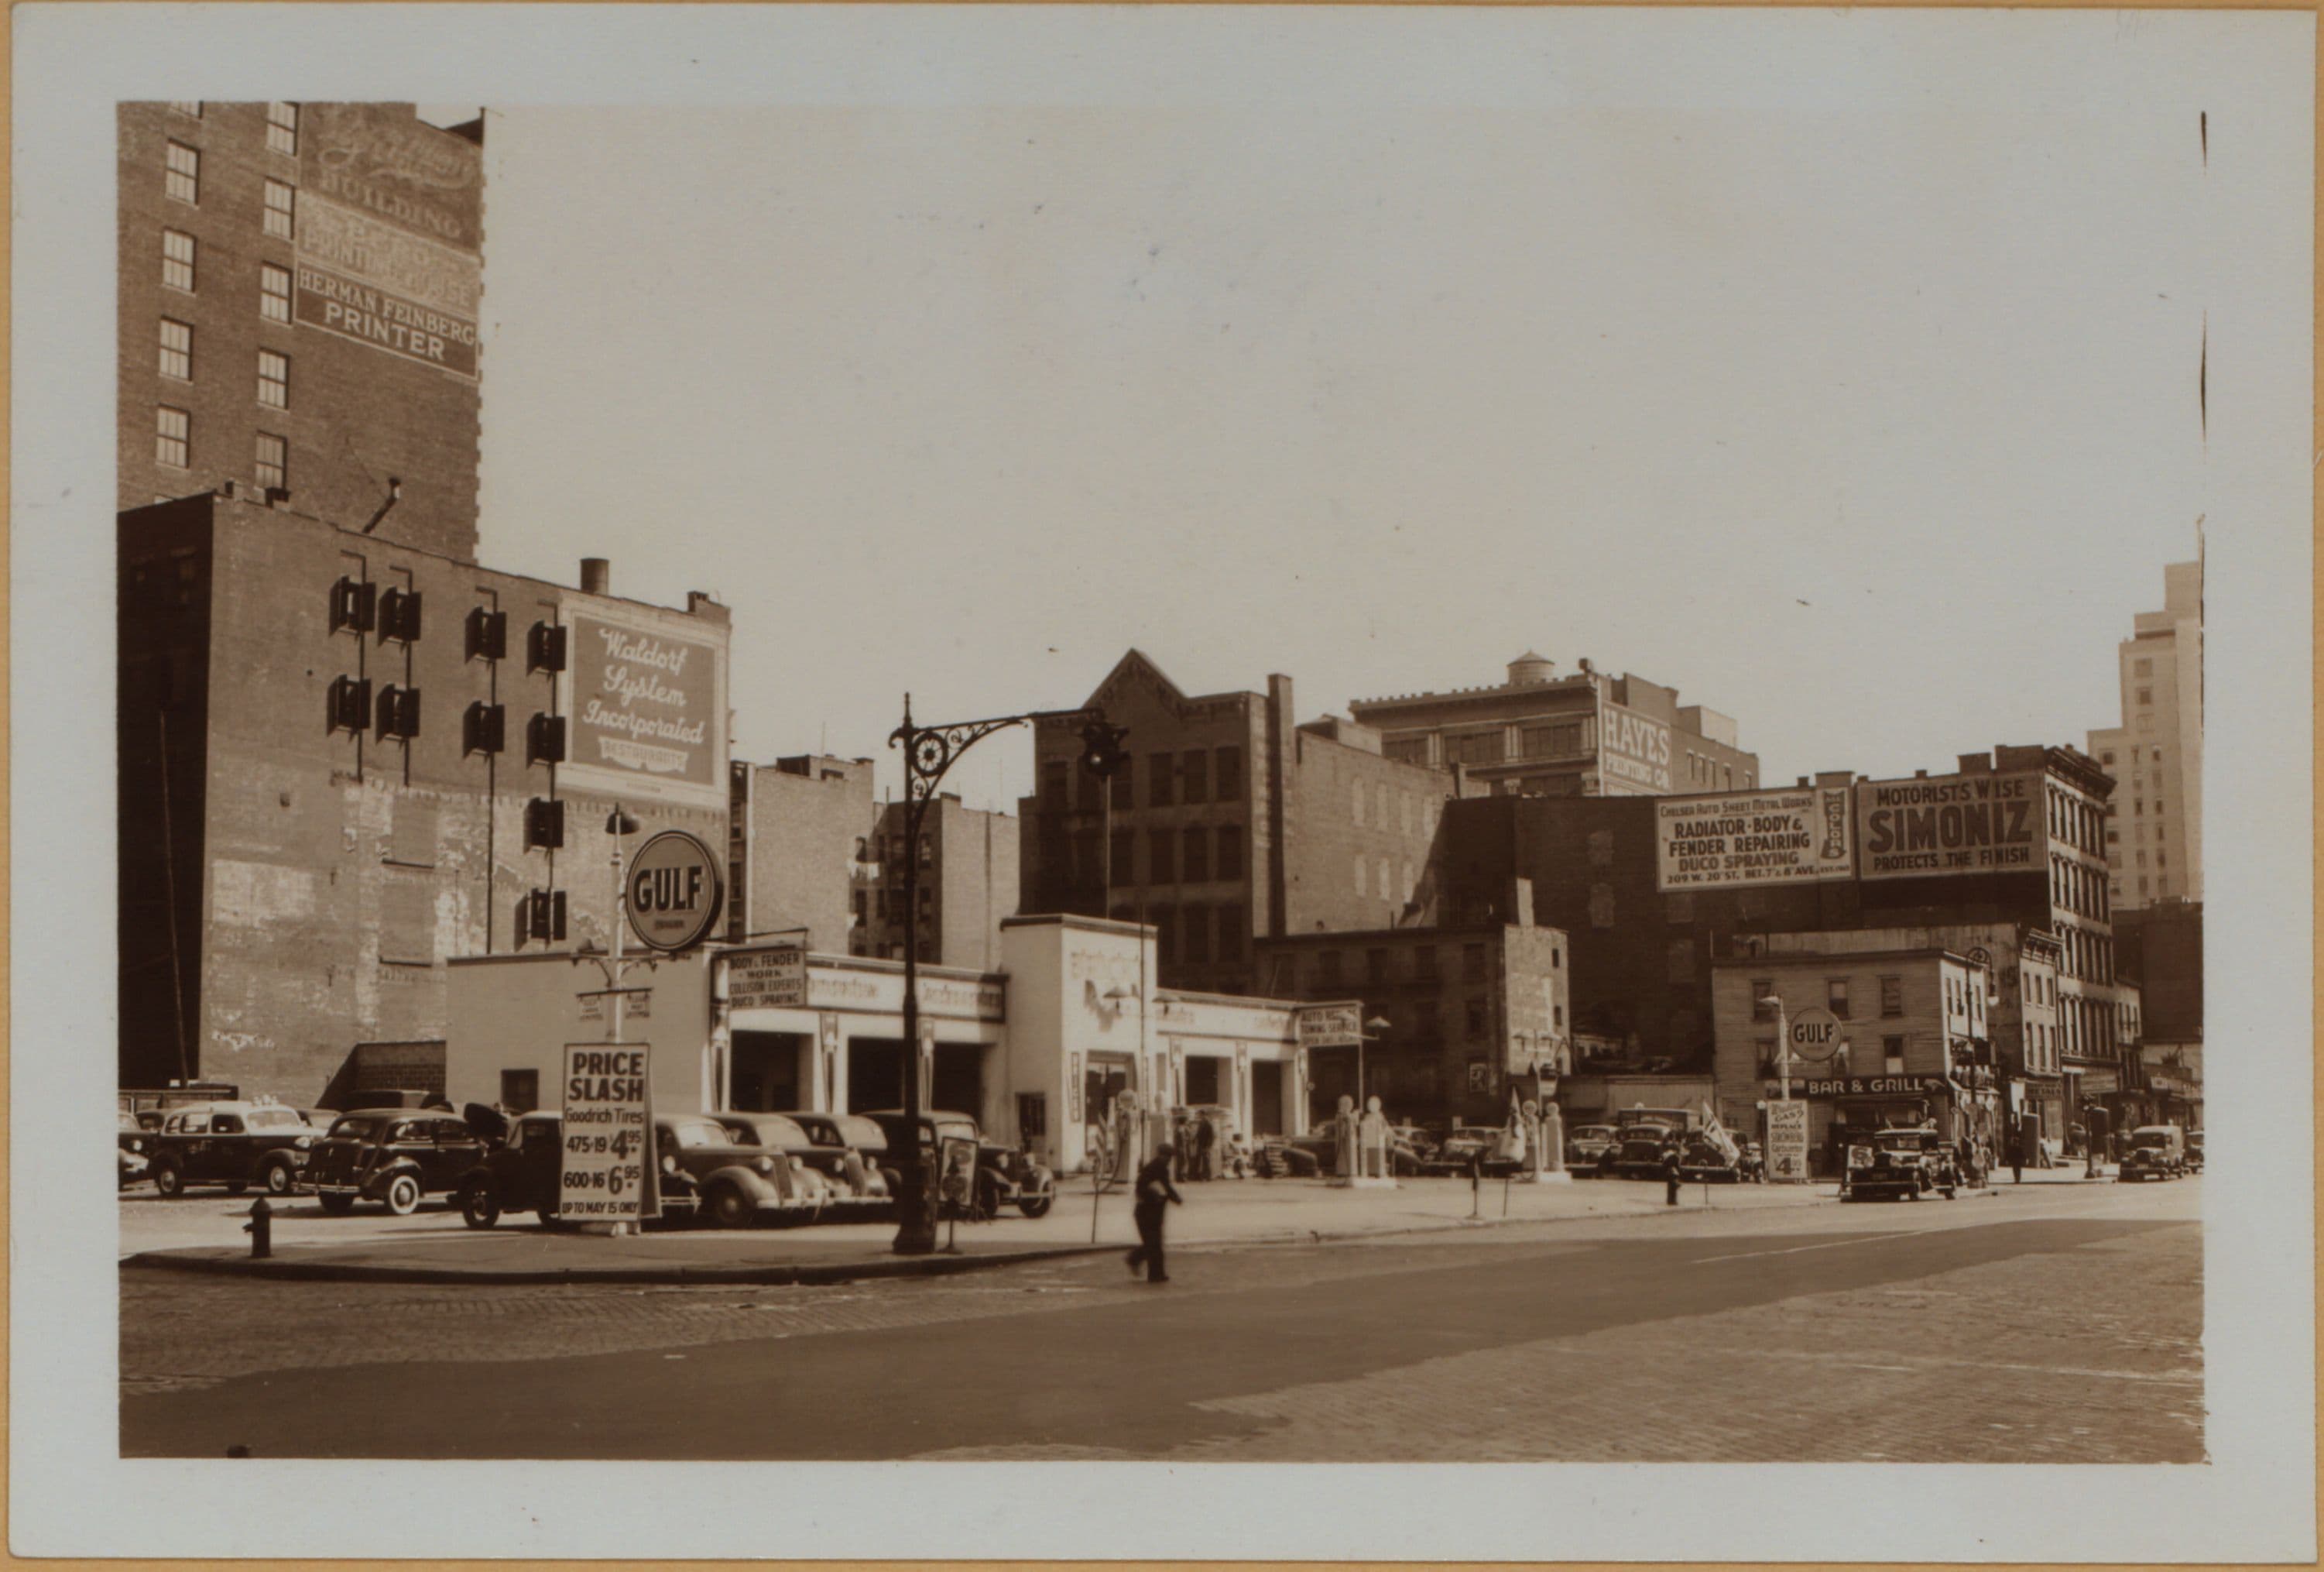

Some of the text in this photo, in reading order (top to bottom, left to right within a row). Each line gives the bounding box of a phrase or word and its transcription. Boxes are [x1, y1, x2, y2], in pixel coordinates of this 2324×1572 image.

[319, 170, 461, 239] BUILDING
[300, 268, 475, 345] HERMAN FEINBERG
[324, 301, 445, 362] PRINTER
[598, 627, 689, 676] Waldorf
[603, 664, 687, 707] System
[583, 699, 705, 743] Incorporated
[1603, 707, 1669, 766] HAYES
[1877, 779, 2024, 806] MOTORISTS WISE
[1674, 814, 1802, 839] RADIATOR BODY &
[1868, 800, 2032, 853] SIMONIZ
[1669, 832, 1810, 858] FENDER REPAIRING
[1678, 851, 1799, 872] DUCO SPRAYING
[1873, 846, 2030, 871] PROTECTS THE FINISH
[633, 865, 702, 913] GULF
[1668, 873, 1688, 884] 209
[730, 956, 752, 970] BODY
[761, 952, 799, 967] FENDER
[730, 981, 765, 995] COLLISION
[768, 979, 801, 992] EXPERTS
[747, 970, 780, 979] WORK
[732, 992, 799, 1007] DUCO SPRAYING
[1794, 1023, 1833, 1043] GULF
[572, 1052, 644, 1076] PRICE
[568, 1078, 644, 1101] SLASH
[1808, 1077, 1925, 1094] BAR & GRILL
[565, 1107, 643, 1123] Goodrich Tires
[562, 1202, 573, 1213] UP
[574, 1202, 584, 1213] TO
[585, 1202, 606, 1213] MAY
[608, 1202, 617, 1213] 15
